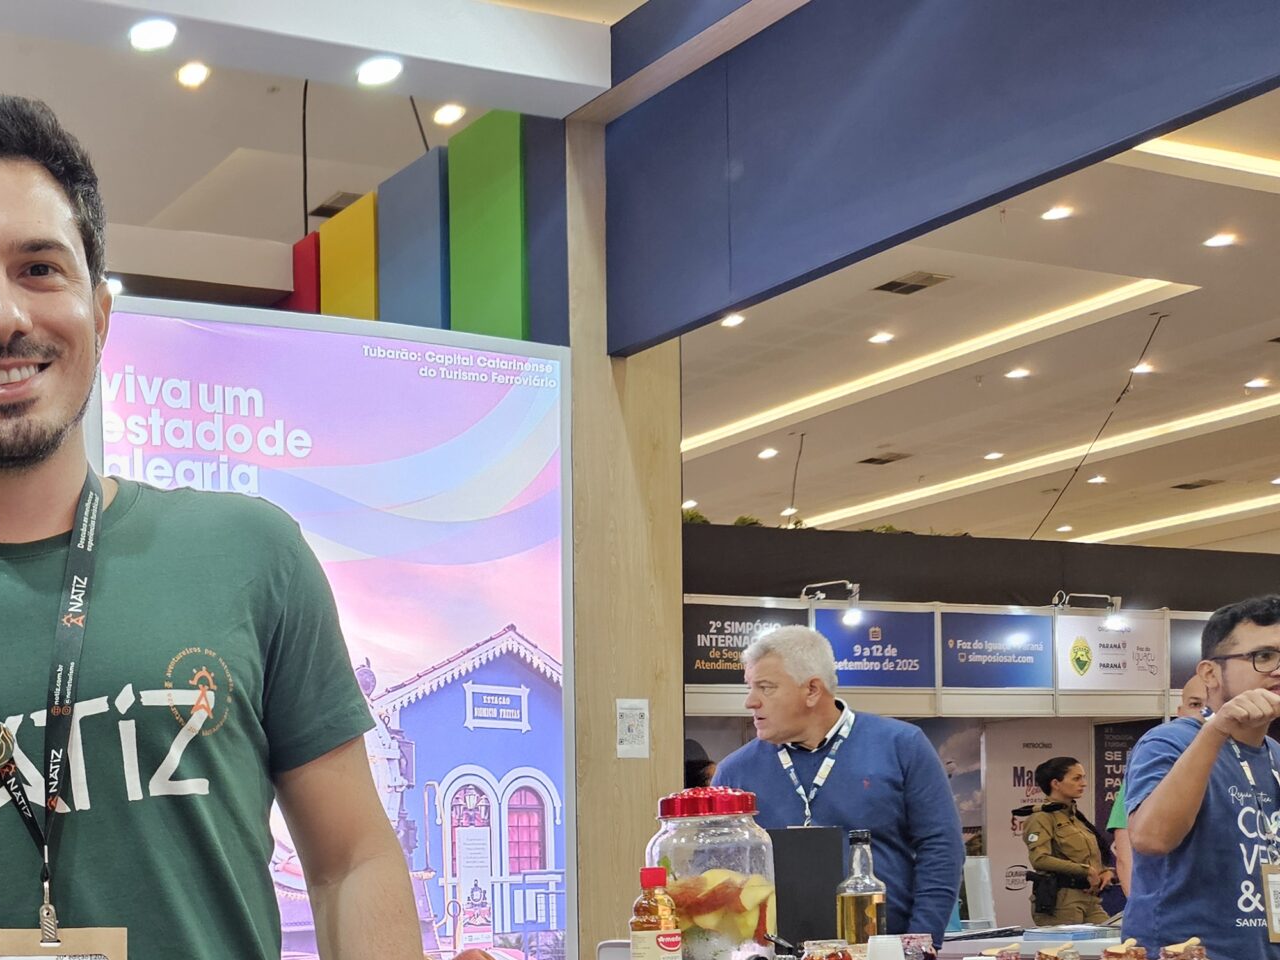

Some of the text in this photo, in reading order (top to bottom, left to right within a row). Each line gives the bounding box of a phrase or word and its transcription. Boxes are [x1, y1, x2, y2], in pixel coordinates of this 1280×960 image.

[425, 352, 473, 368] Capital
[477, 357, 553, 374] Catarinense
[419, 366, 557, 389] do Turismo Ferroviário
[101, 365, 264, 418] viva um
[103, 408, 313, 459] estado de
[956, 639, 971, 650] Foz
[972, 640, 984, 650] do
[709, 649, 721, 659] de
[853, 645, 898, 657] 9 a 12 de
[968, 653, 1034, 664] simposiosat.com
[882, 659, 894, 671] de
[896, 659, 920, 671] 2025
[1104, 751, 1122, 761] SE
[1237, 880, 1265, 913] &
[1235, 918, 1268, 927] SANTA
